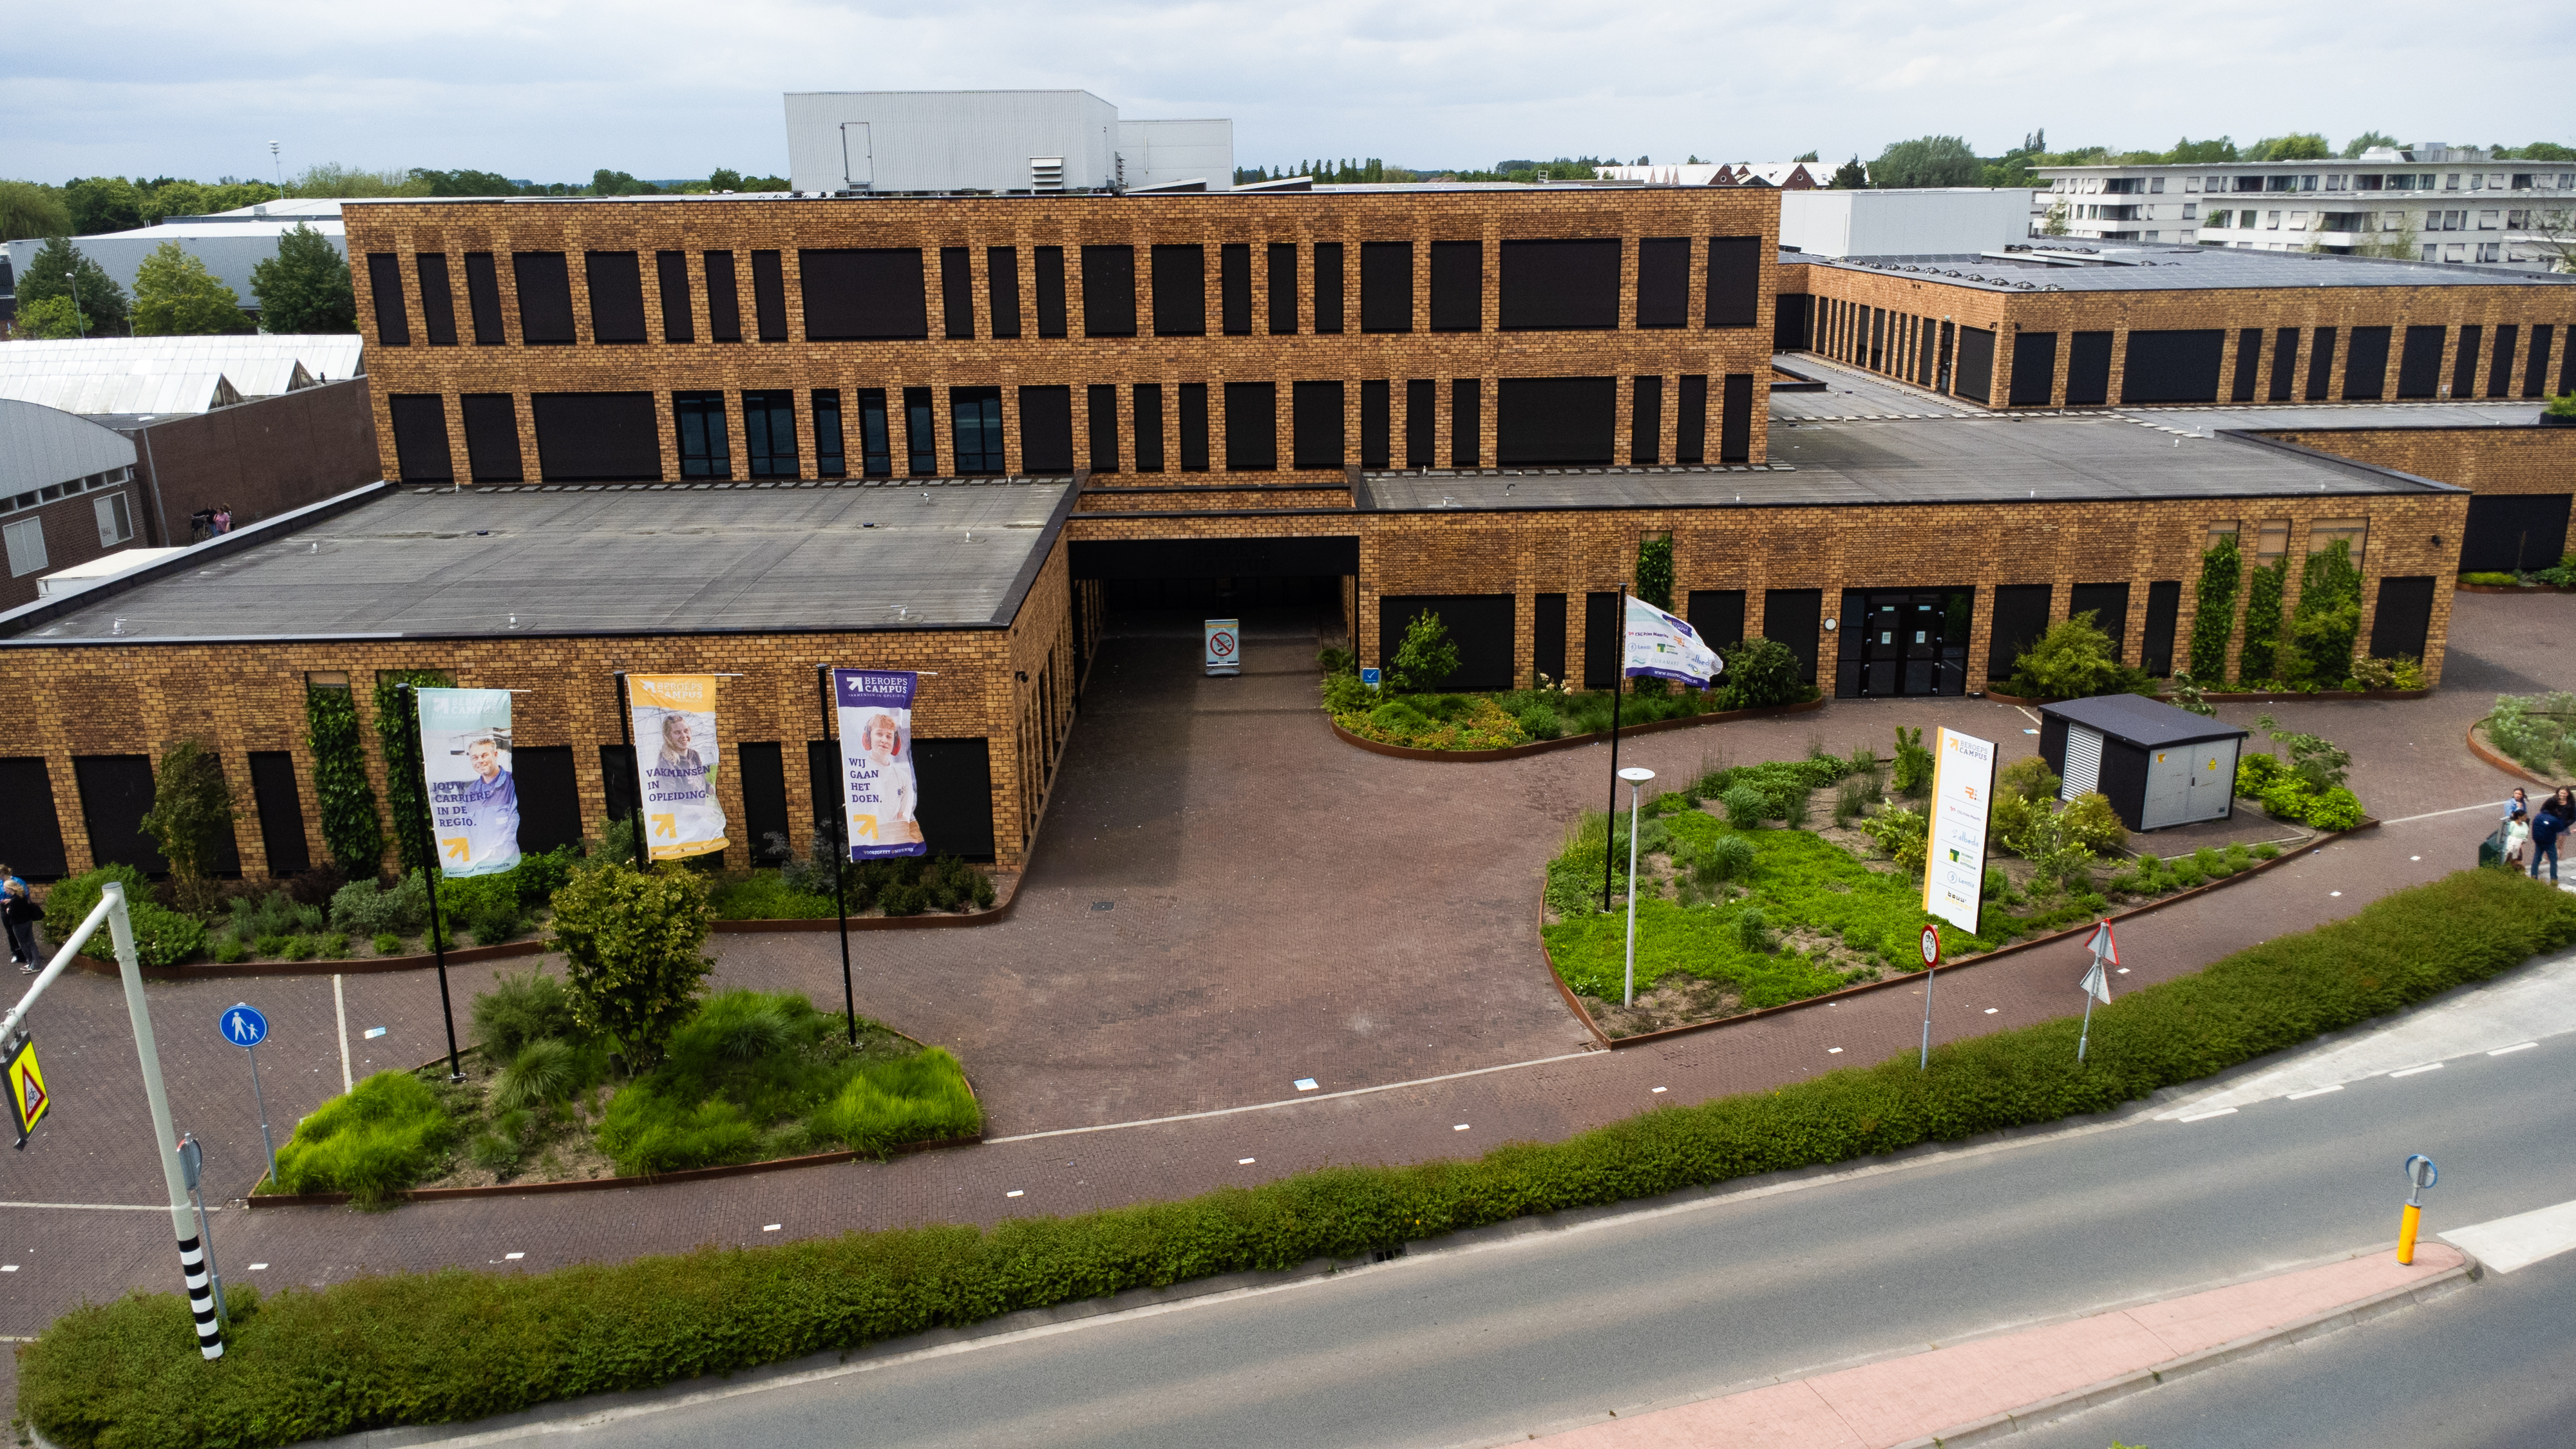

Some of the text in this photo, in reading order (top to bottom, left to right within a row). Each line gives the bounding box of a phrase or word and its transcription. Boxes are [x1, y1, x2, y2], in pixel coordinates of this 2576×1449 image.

[864, 677, 907, 685] BEROEPS
[658, 683, 703, 691] BEROEPS
[865, 685, 907, 694] CAMPUS
[1960, 741, 1988, 755] BEROEPS
[1960, 747, 1987, 761] CAMPUS
[848, 758, 866, 768] WIJ
[646, 765, 711, 777] VAKMENSEN
[850, 770, 878, 779] GAAN
[433, 782, 465, 791] JOUW
[648, 781, 659, 790] IN
[851, 782, 870, 791] HET
[435, 790, 491, 802] CARRIÈRE
[649, 790, 709, 801] OPLEIDING.
[852, 794, 882, 802] DOEN.
[452, 806, 467, 814] DE
[439, 818, 477, 827] REGIO.
[1958, 831, 1978, 847] albeda
[1958, 877, 1975, 888] Lentiz
